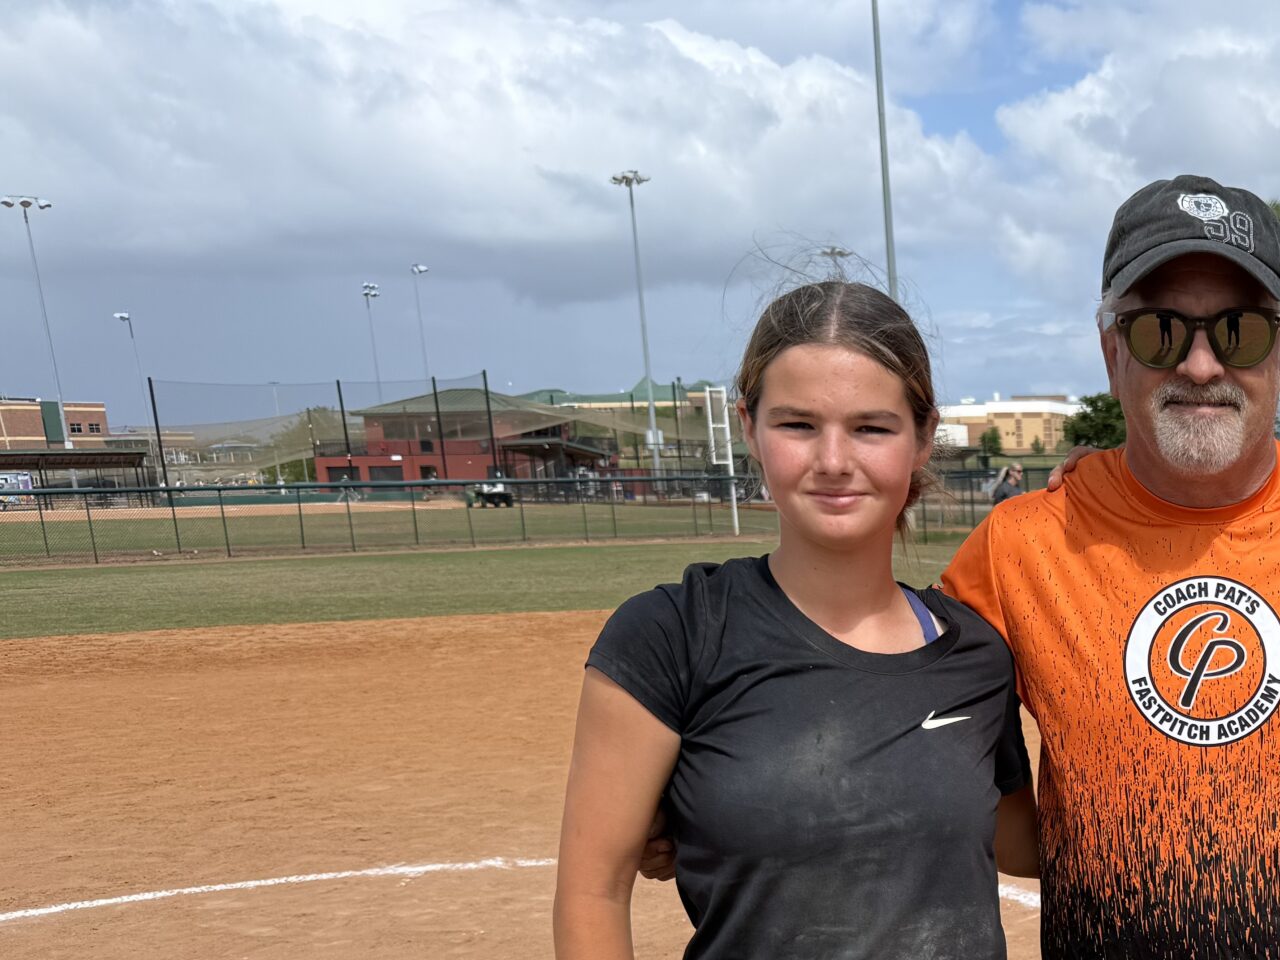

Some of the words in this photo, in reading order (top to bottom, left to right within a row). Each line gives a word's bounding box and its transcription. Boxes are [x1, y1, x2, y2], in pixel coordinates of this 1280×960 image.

[1153, 581, 1209, 617] COACH
[1214, 582, 1261, 616] PAT'S
[1131, 676, 1210, 741] FASTPITCH
